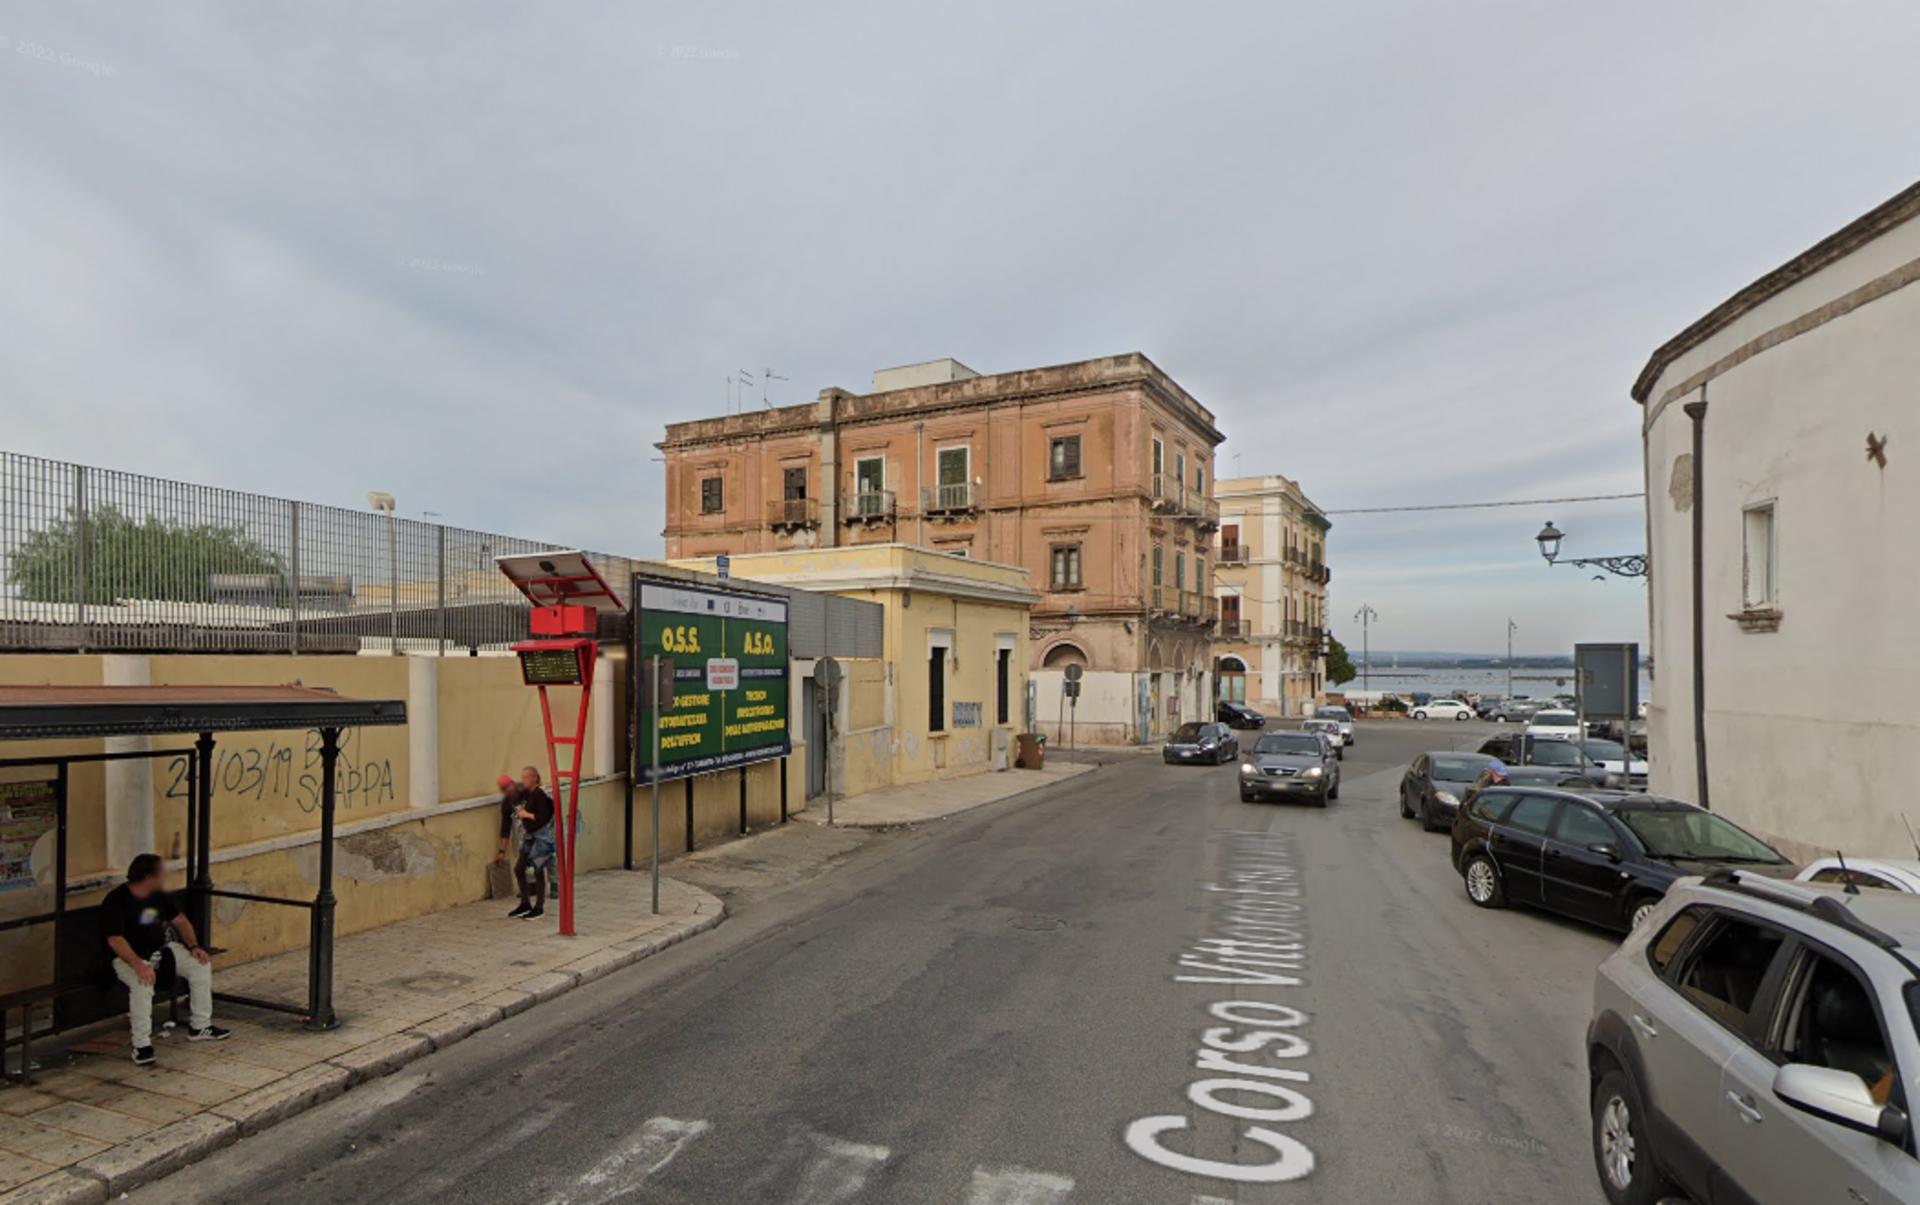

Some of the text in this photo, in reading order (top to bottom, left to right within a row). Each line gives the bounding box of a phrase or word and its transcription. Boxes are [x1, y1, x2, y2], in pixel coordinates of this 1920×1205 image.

[662, 627, 701, 653] O.S.S.
[744, 632, 775, 655] A.S.O.
[304, 726, 362, 769] BRI
[165, 742, 293, 800] 2/03/19
